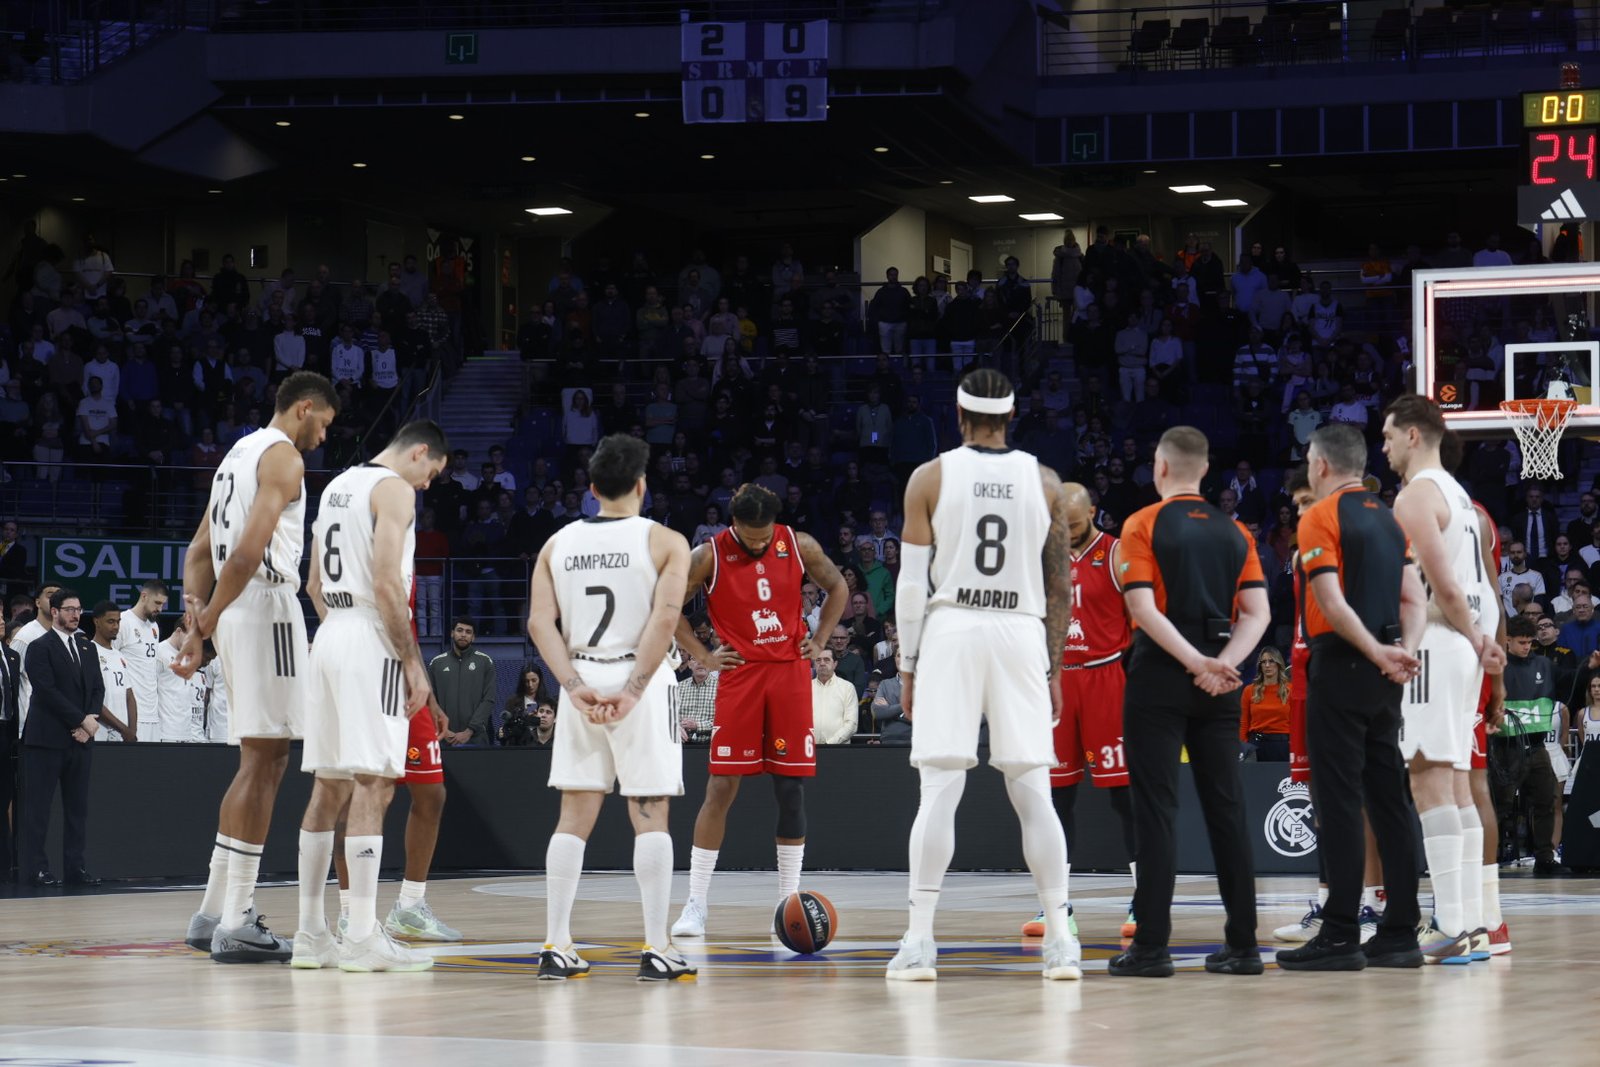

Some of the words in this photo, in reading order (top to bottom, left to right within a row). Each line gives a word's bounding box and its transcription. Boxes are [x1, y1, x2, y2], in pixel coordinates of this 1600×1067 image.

[701, 24, 724, 56] 2
[783, 22, 805, 54] 0
[701, 86, 724, 119] 0
[785, 84, 807, 118] 9
[1532, 133, 1595, 185] 24
[974, 482, 1014, 499] OKEKE
[975, 514, 1008, 577] 8
[564, 553, 630, 571] CAMPAZZO
[756, 577, 772, 601] 6
[956, 588, 1019, 609] MADRID
[585, 585, 616, 648] 7
[145, 642, 156, 658] 25
[752, 634, 789, 645] plenitude
[113, 671, 124, 687] 12
[804, 734, 814, 758] 6
[1101, 743, 1125, 769] 31
